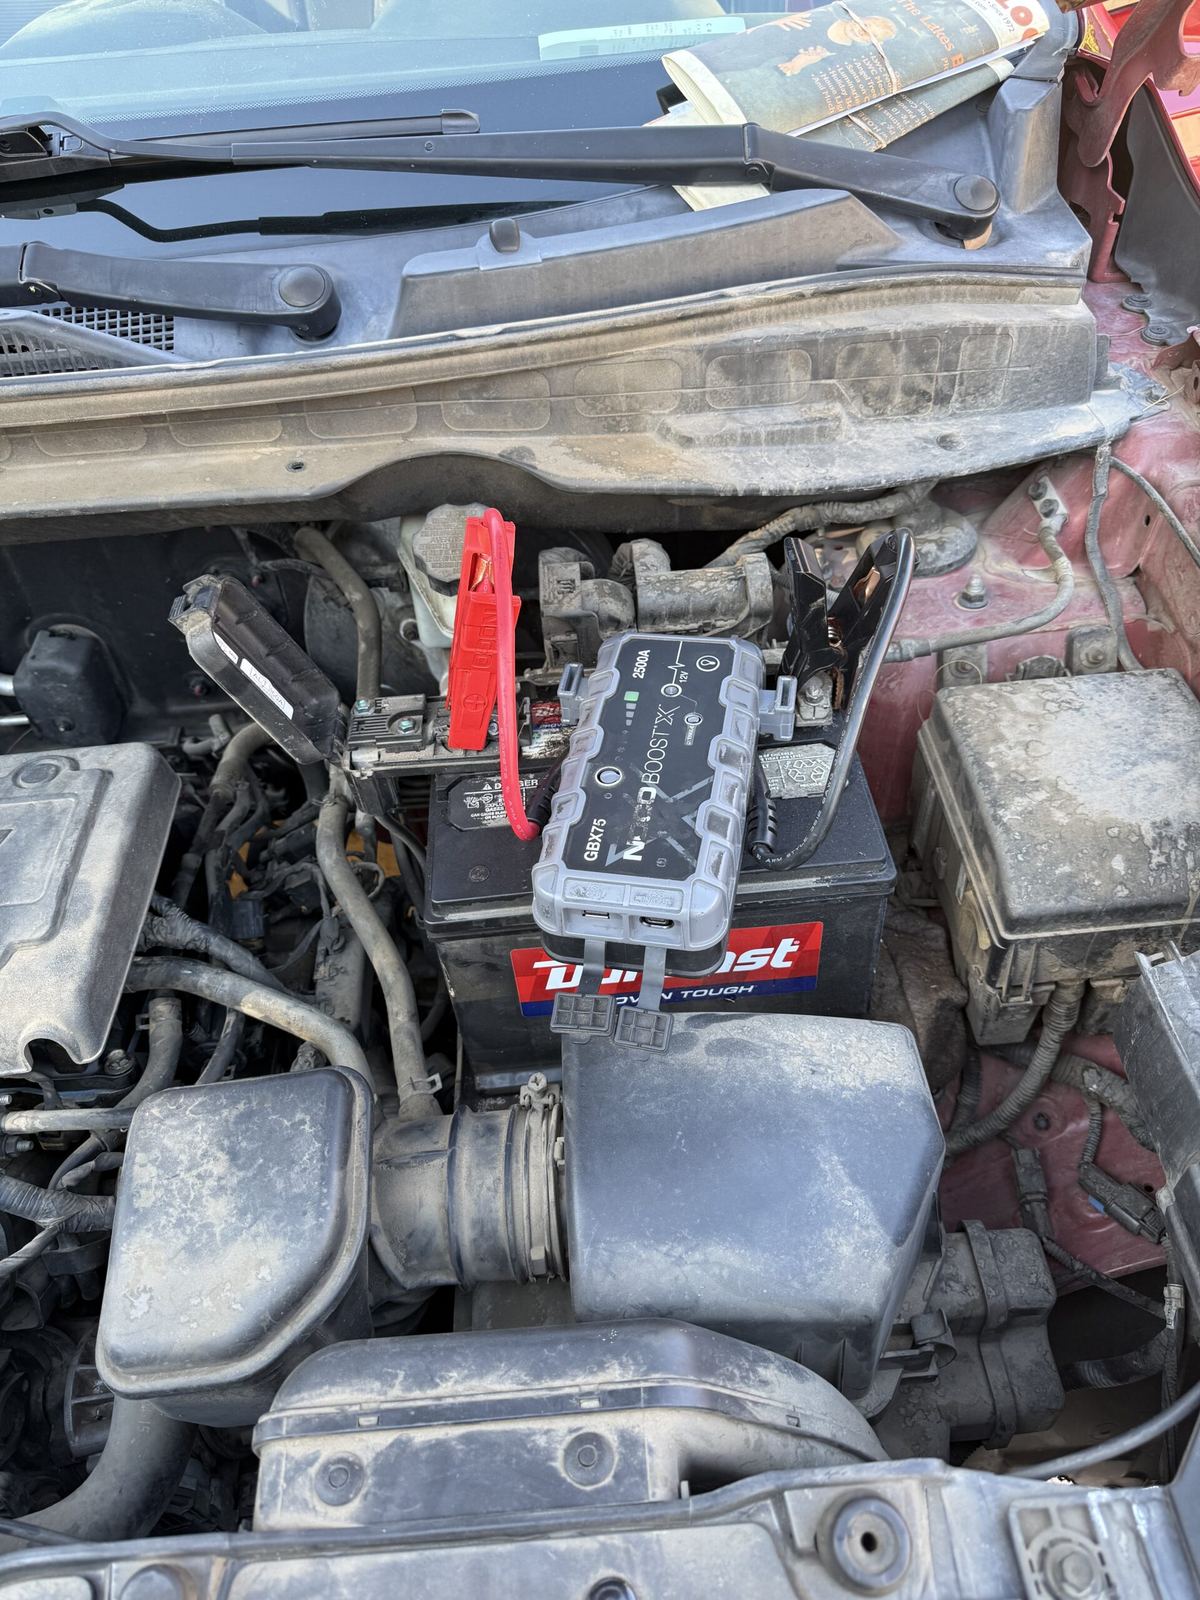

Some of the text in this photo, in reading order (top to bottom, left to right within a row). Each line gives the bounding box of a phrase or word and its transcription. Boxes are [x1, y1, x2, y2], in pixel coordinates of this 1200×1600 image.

[919, 14, 955, 52] Lakes
[829, 69, 848, 96] Holiday
[846, 63, 860, 82] Santa
[632, 649, 651, 679] 2500A
[679, 670, 689, 683] 12V
[494, 778, 538, 789] DGER
[623, 786, 657, 861] NCO
[641, 727, 670, 784] BOOST
[583, 818, 607, 861] GBX75
[680, 985, 754, 999] TOUGH
